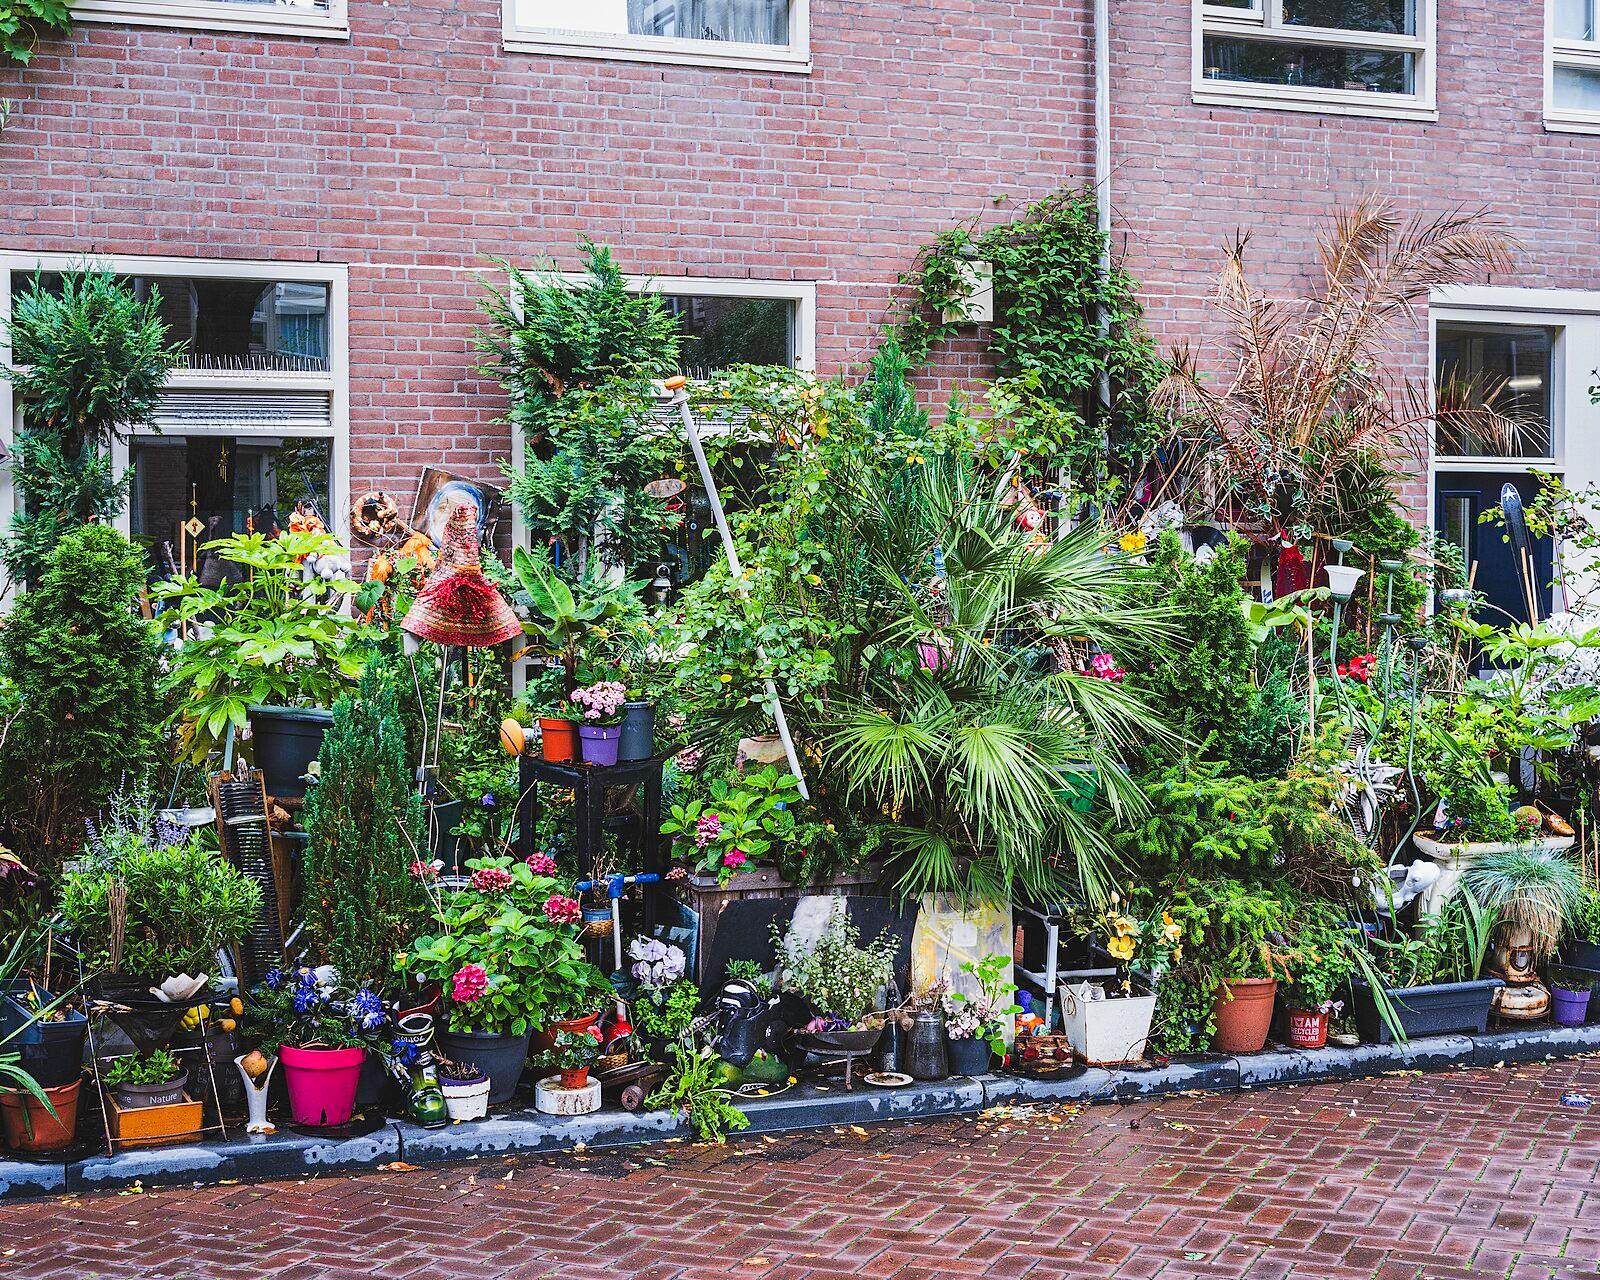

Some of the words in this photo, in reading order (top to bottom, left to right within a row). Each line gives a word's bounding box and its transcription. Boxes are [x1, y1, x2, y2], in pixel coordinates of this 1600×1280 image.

[1305, 1017, 1320, 1027] AM
[1291, 1027, 1320, 1035] RECYCLED
[149, 1093, 177, 1104] Nature
